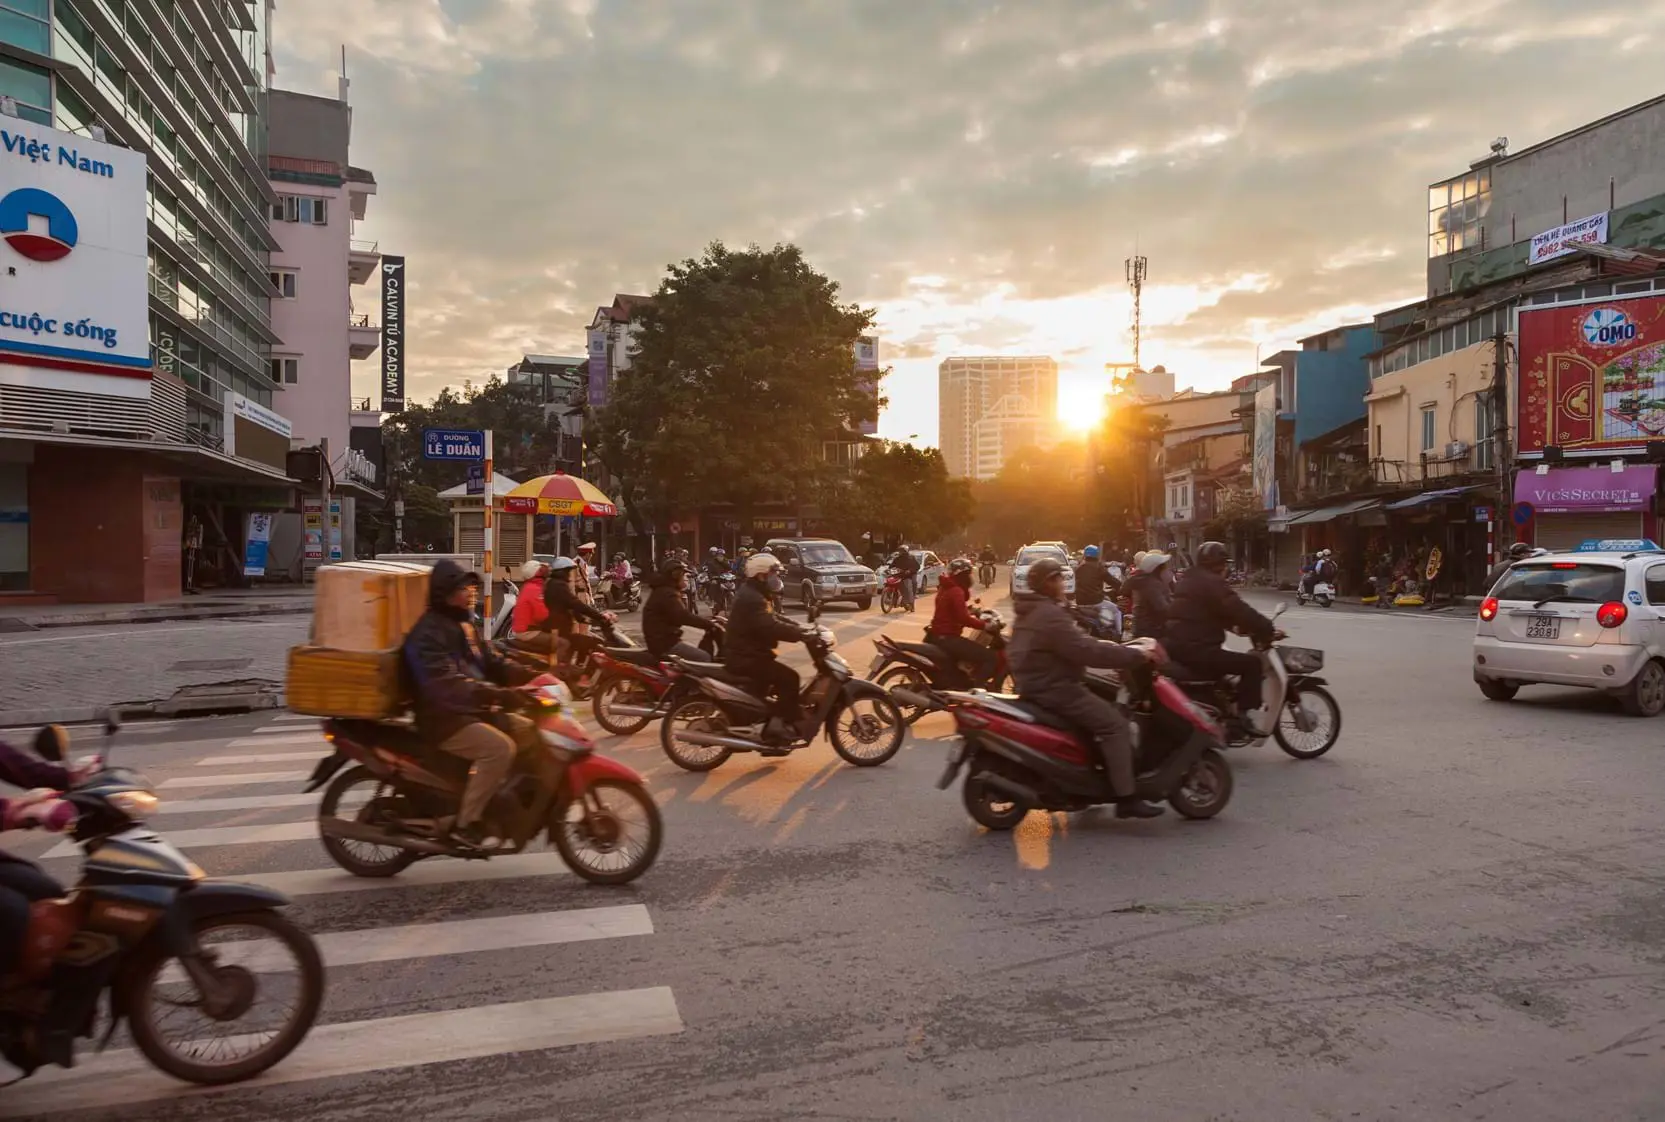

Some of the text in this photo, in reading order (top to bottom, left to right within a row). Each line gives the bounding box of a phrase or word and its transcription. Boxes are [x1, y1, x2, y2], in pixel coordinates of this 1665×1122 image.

[1, 130, 114, 179] Việt Nam
[386, 277, 399, 321] CALVIN
[0, 311, 117, 349] cuộc sống
[386, 322, 401, 335] TÚ
[1599, 324, 1635, 342] OMO
[386, 337, 399, 395] ACADEMY
[427, 441, 480, 456] LÊ DUẨN
[1535, 616, 1552, 627] 29A
